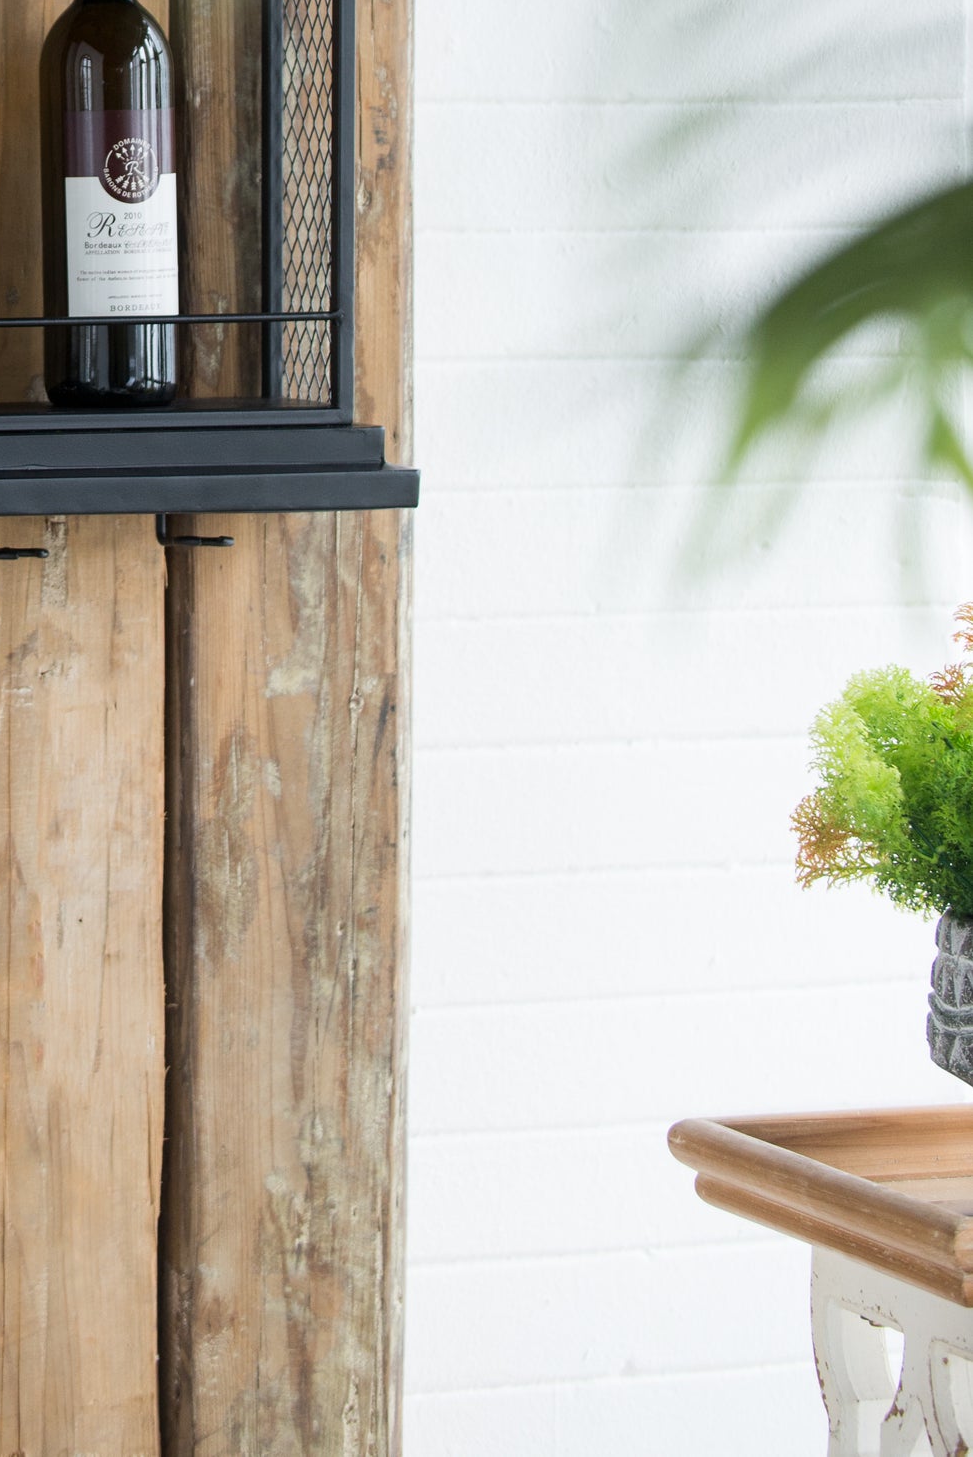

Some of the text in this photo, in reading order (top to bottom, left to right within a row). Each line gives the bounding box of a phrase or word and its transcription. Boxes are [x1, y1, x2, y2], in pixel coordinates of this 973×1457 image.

[102, 167, 123, 195] BARONS
[121, 190, 132, 198] DE
[123, 211, 142, 220] 2010
[84, 241, 122, 249] Bordeaux
[110, 302, 162, 312] BORDEAUX
